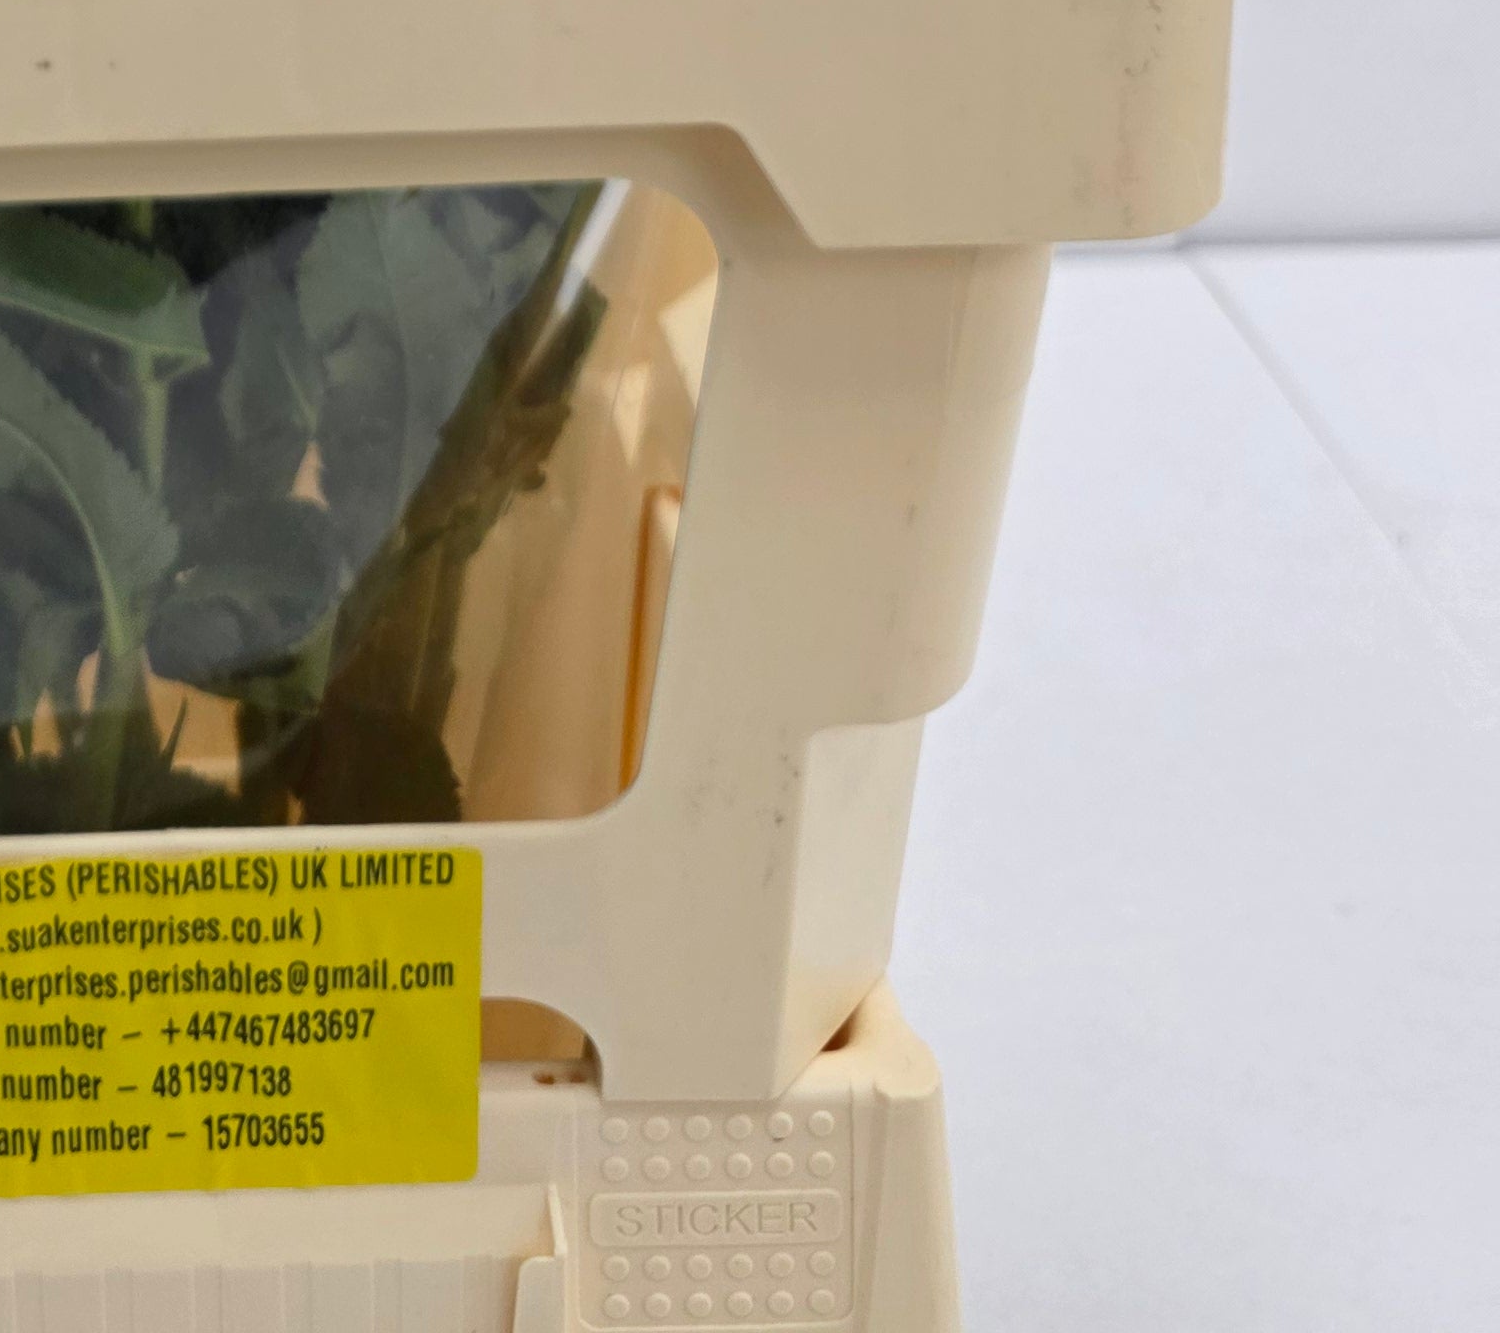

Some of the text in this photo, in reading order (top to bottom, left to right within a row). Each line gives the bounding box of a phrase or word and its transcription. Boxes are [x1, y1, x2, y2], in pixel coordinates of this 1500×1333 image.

[66, 854, 280, 902] (PERISHABLES)
[289, 852, 330, 891] UK
[339, 850, 456, 890] LIMITED
[4, 1014, 107, 1051] number
[160, 1007, 376, 1048] +447467483697
[0, 1065, 103, 1102] number
[151, 1060, 293, 1099] 481997138
[51, 1119, 153, 1156] number
[201, 1111, 325, 1152] 15703655
[615, 1200, 818, 1236] STICKER
